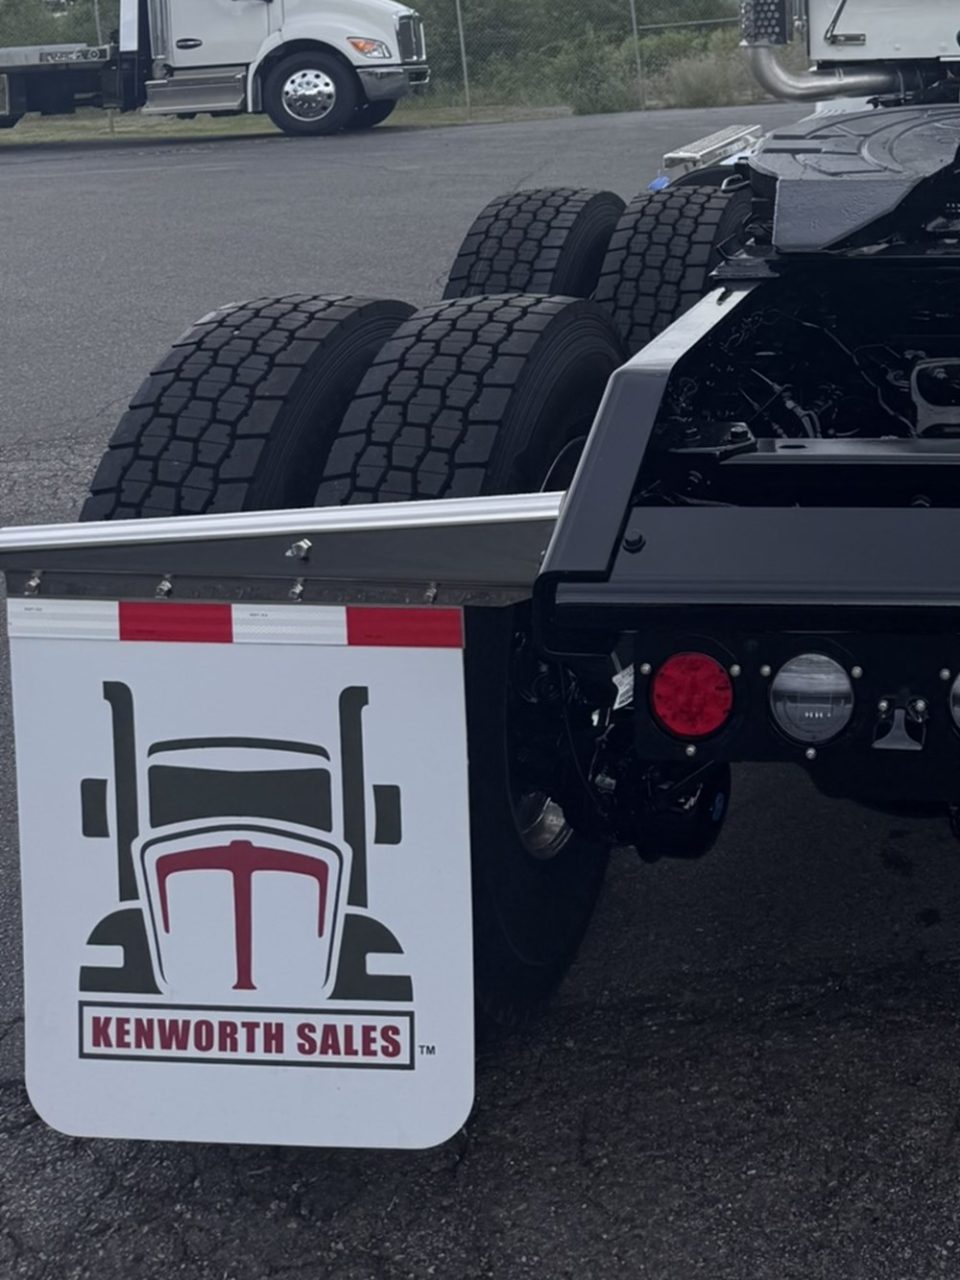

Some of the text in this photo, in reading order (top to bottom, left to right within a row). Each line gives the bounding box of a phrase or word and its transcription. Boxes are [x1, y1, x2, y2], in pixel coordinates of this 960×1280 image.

[92, 1017, 402, 1058] KENWORTH SALES
[418, 1045, 436, 1056] TM
